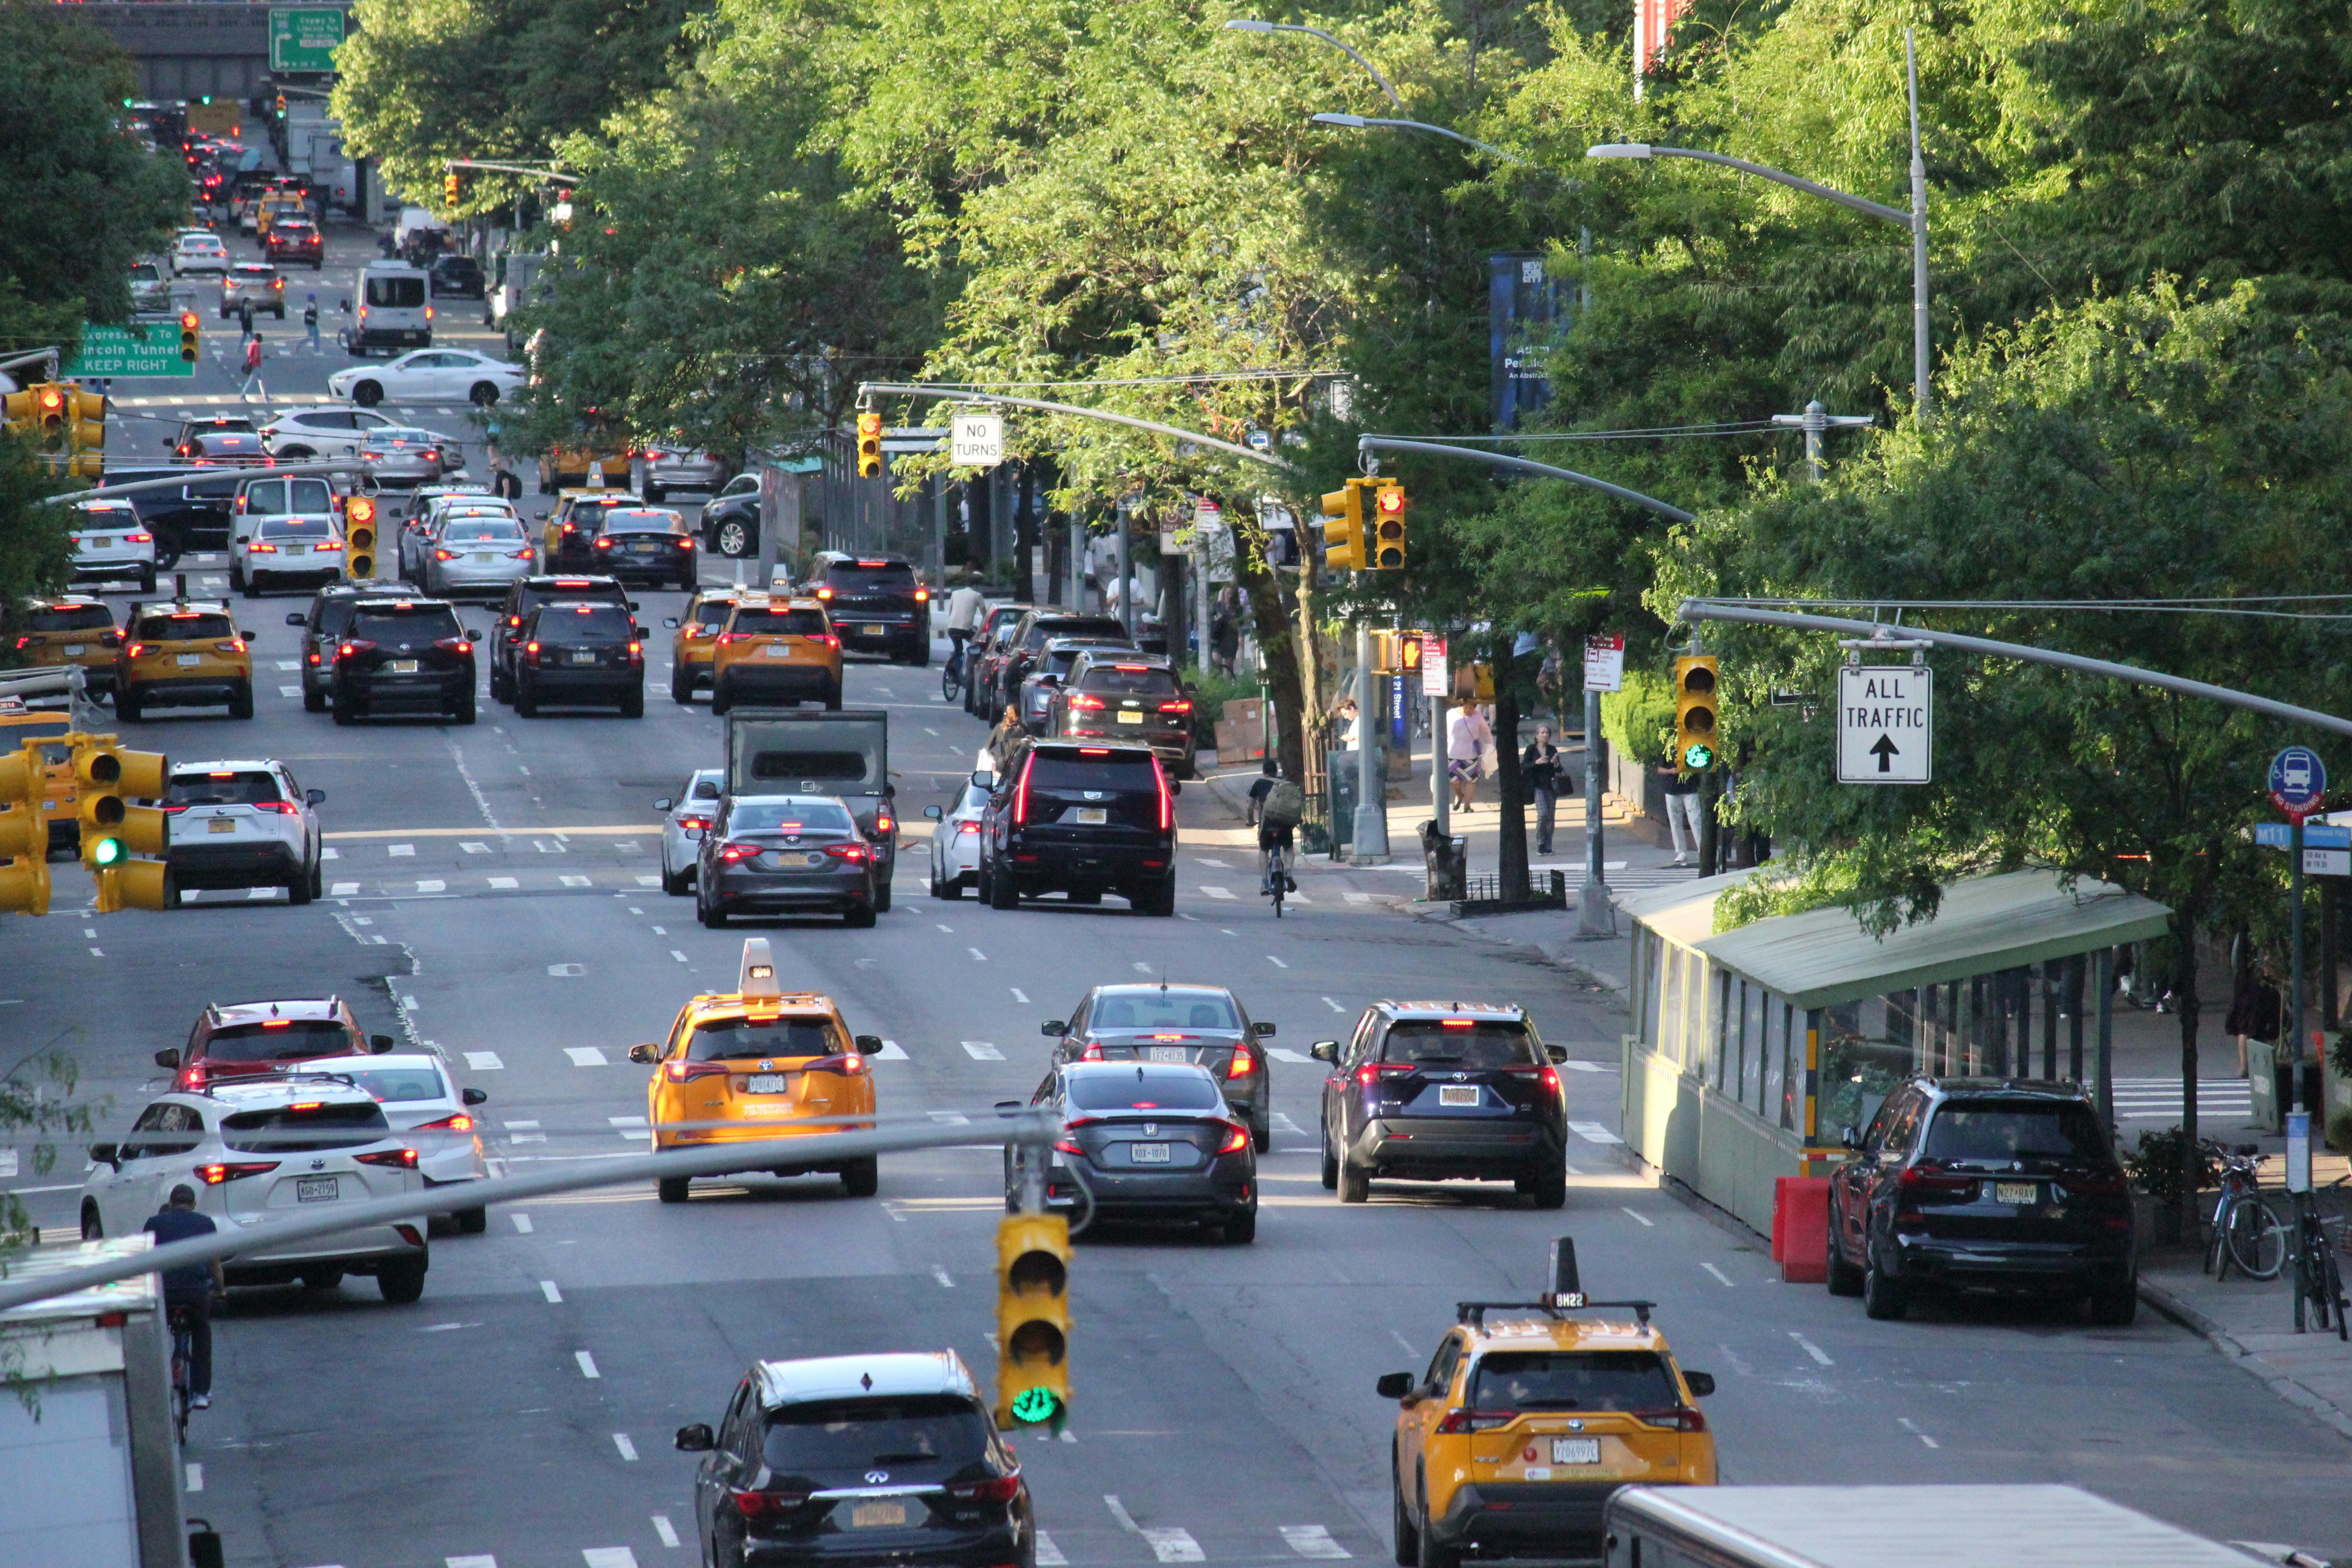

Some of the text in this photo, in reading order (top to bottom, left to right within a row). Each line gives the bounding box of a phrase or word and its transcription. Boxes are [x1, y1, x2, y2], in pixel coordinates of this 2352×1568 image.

[159, 330, 172, 339] To
[83, 344, 179, 355] incoln Tunnel
[85, 360, 168, 371] KEEP RIGHT
[967, 425, 986, 437] NO
[956, 444, 997, 456] TURNS
[1393, 681, 1401, 691] 21
[1865, 679, 1905, 698] ALL
[1393, 693, 1401, 719] Street
[1847, 708, 1923, 727] TRAFFIC
[2274, 793, 2320, 812] NO STANDING
[2258, 827, 2284, 842] M11
[1556, 1292, 1583, 1307] 8H22
